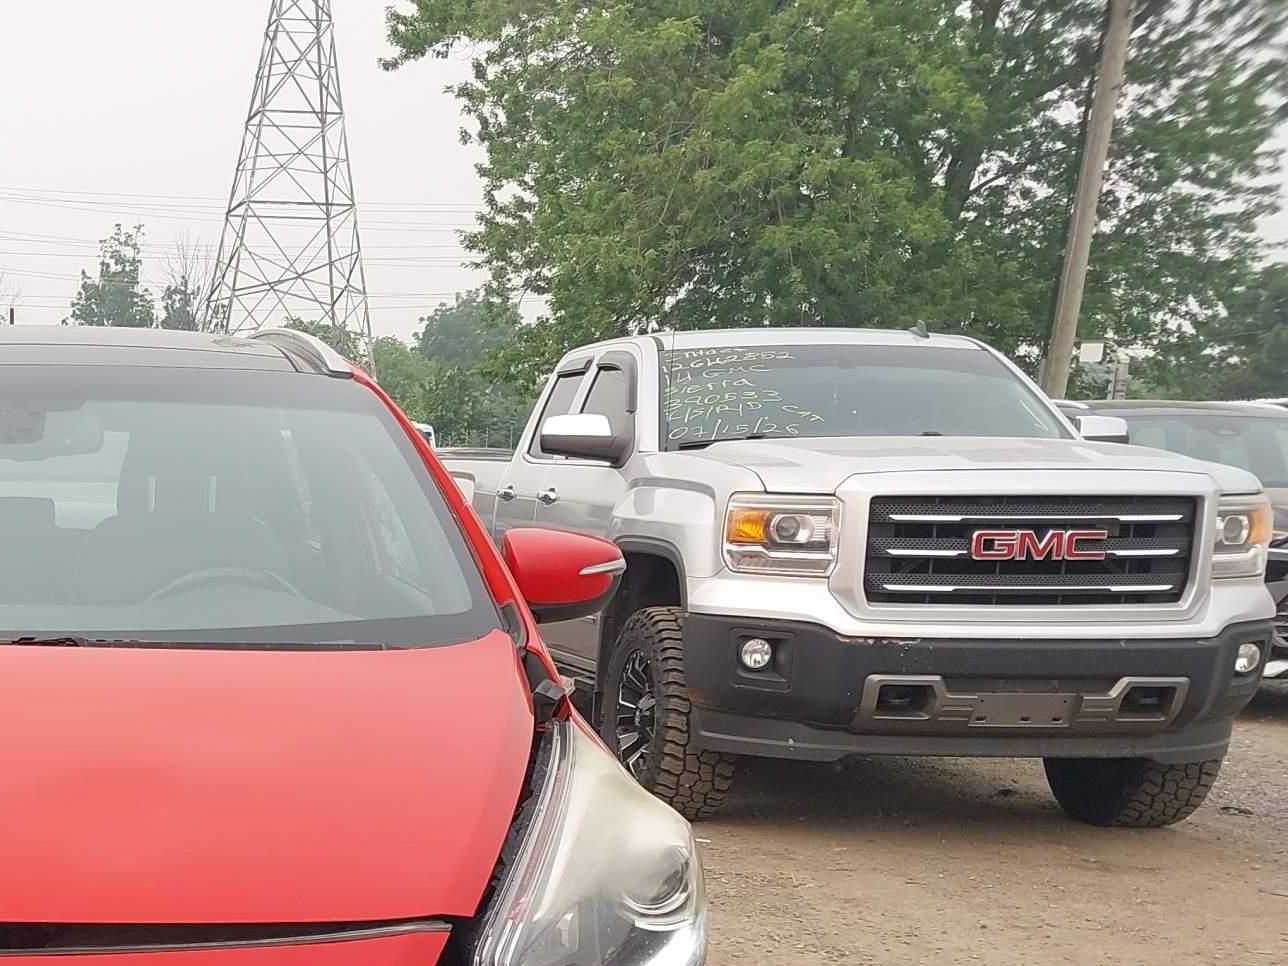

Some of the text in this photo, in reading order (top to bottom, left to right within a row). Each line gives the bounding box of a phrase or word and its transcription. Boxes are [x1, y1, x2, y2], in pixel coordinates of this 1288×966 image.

[702, 364, 773, 378] GMC
[668, 416, 801, 440] 07/15/26
[972, 529, 1108, 560] GMC
